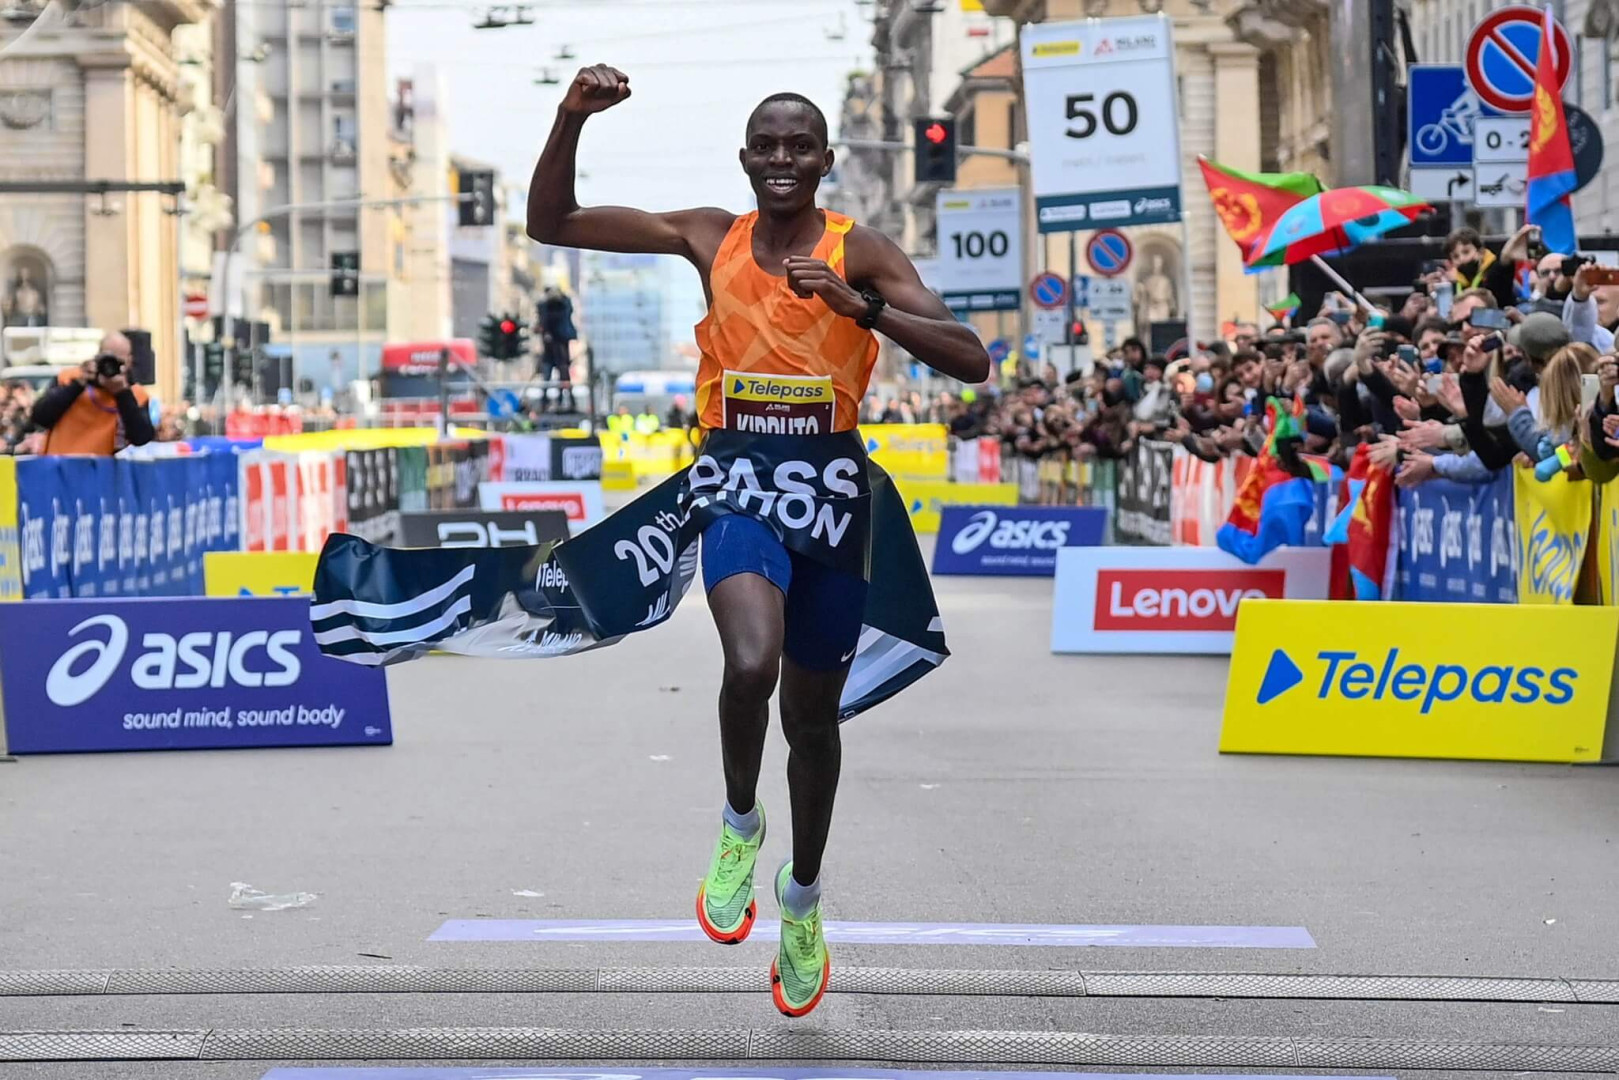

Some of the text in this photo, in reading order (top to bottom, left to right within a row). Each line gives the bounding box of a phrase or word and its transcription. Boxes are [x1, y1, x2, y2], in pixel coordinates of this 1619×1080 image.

[1065, 91, 1138, 139] 50
[1486, 130, 1501, 150] 0
[951, 229, 1009, 259] 100
[748, 380, 824, 399] Telepass
[990, 520, 1072, 549] asics
[1109, 581, 1267, 618] Lenov
[131, 629, 302, 690] asics
[1316, 648, 1579, 715] Telepass
[122, 704, 345, 730] sound mind, sound body
